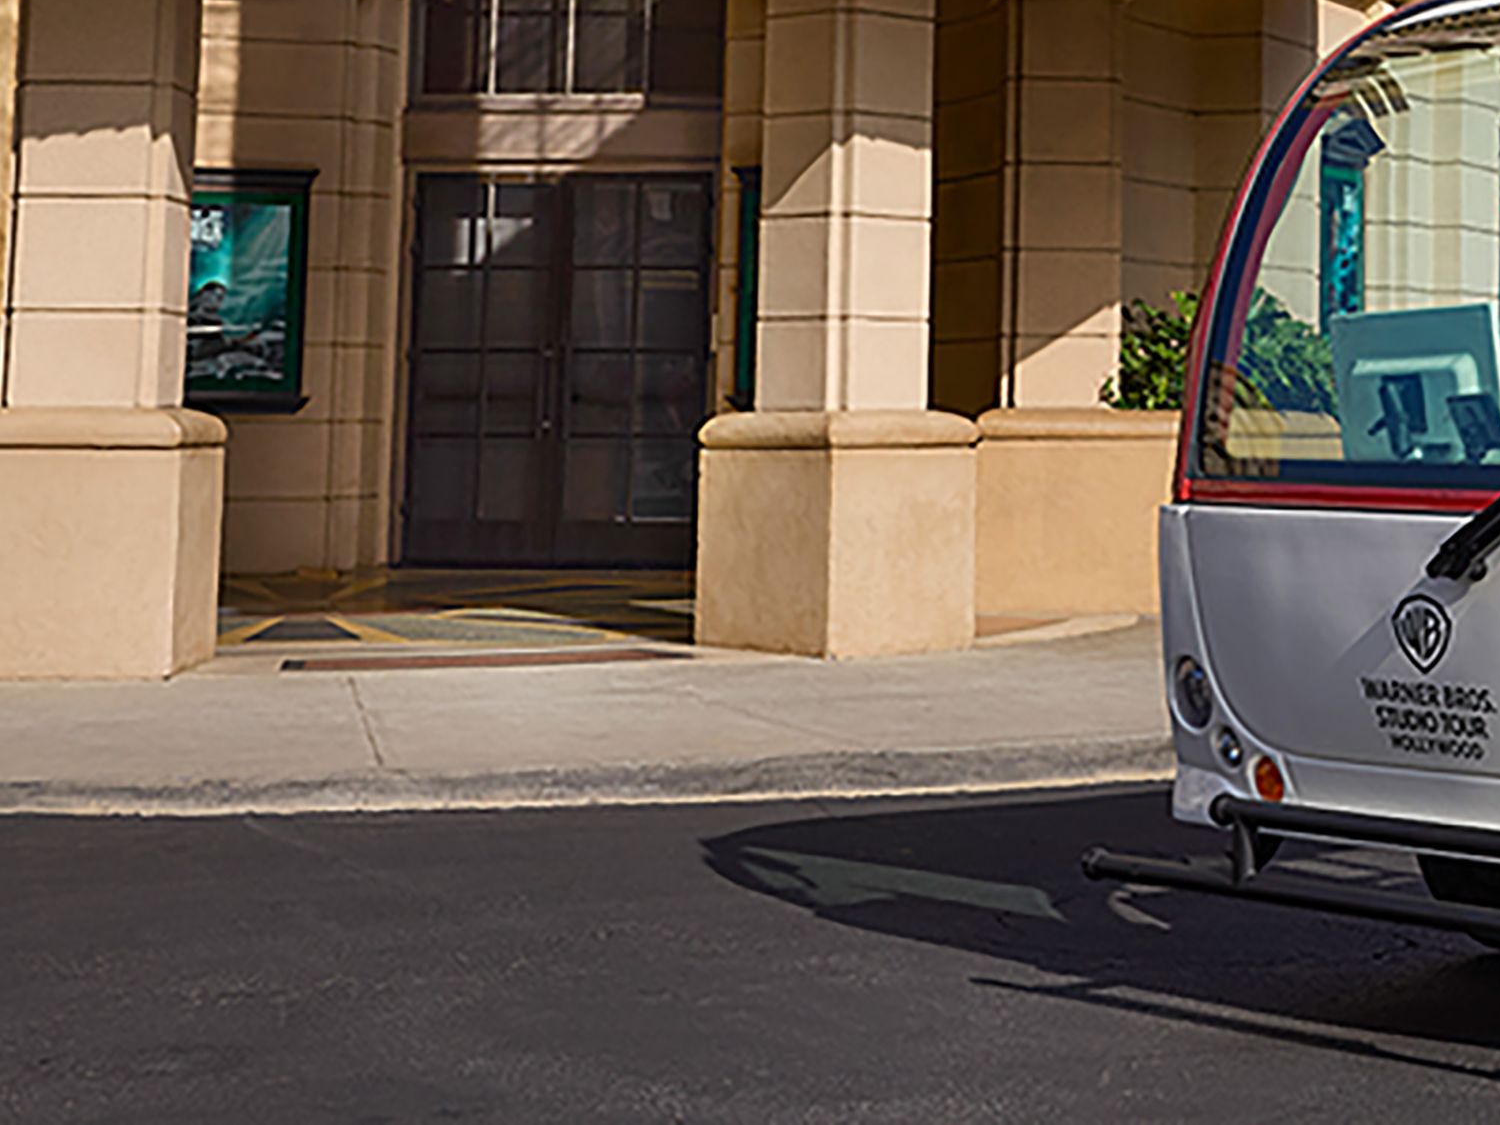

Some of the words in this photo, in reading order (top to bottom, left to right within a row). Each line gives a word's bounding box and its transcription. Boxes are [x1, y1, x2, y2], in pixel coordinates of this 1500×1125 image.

[1360, 676, 1441, 707] WARNER
[1374, 705, 1439, 733] STUDIO
[1440, 711, 1490, 740] TOUR
[1389, 733, 1485, 762] HOLLYWOOD
